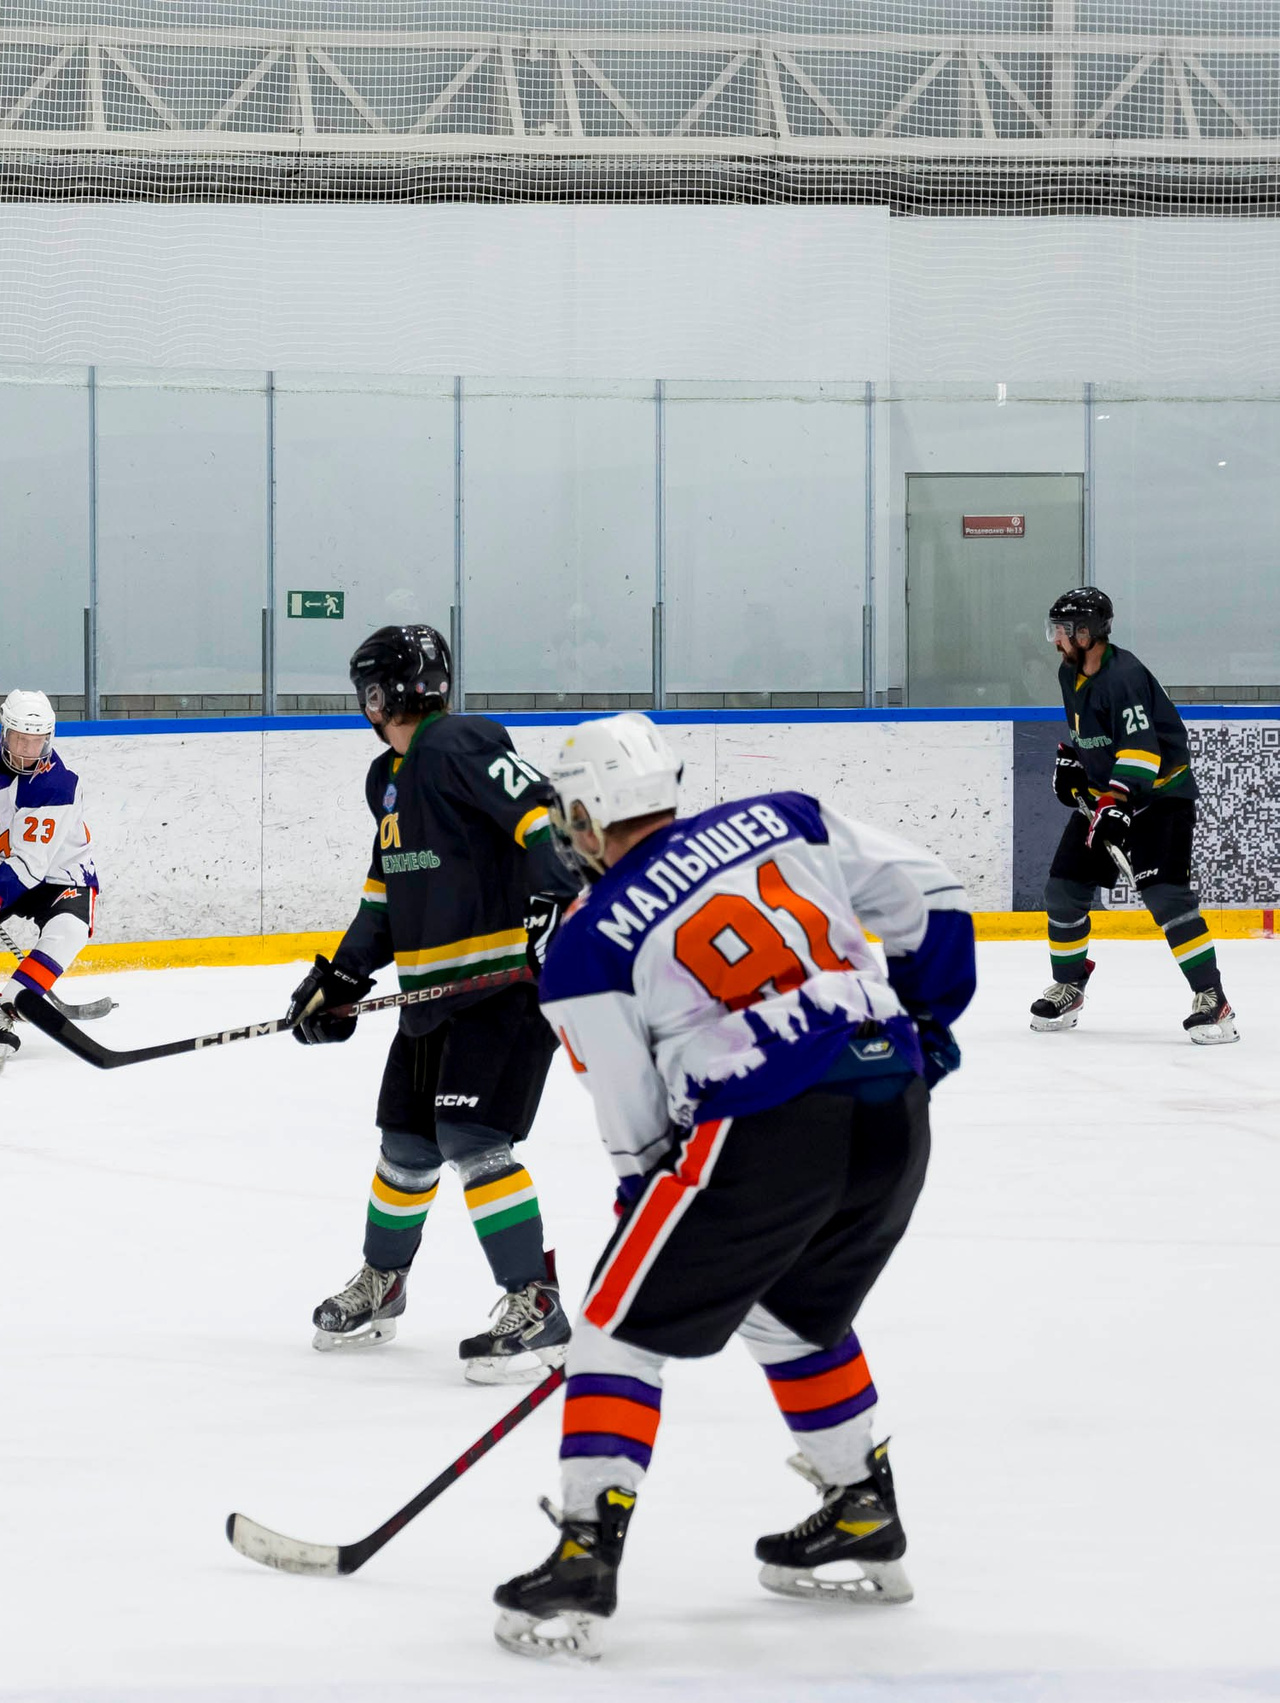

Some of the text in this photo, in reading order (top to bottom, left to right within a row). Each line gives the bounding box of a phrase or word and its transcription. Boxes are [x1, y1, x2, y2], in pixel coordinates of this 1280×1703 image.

[1122, 704, 1150, 735] 25
[23, 816, 56, 845] 23
[596, 804, 789, 951] МАЛЫШЕВ
[674, 859, 859, 1012] 91
[333, 969, 359, 985] CCM
[348, 987, 443, 1017] JETSPEED
[195, 1020, 278, 1050] CCM
[435, 1094, 479, 1107] CCM
